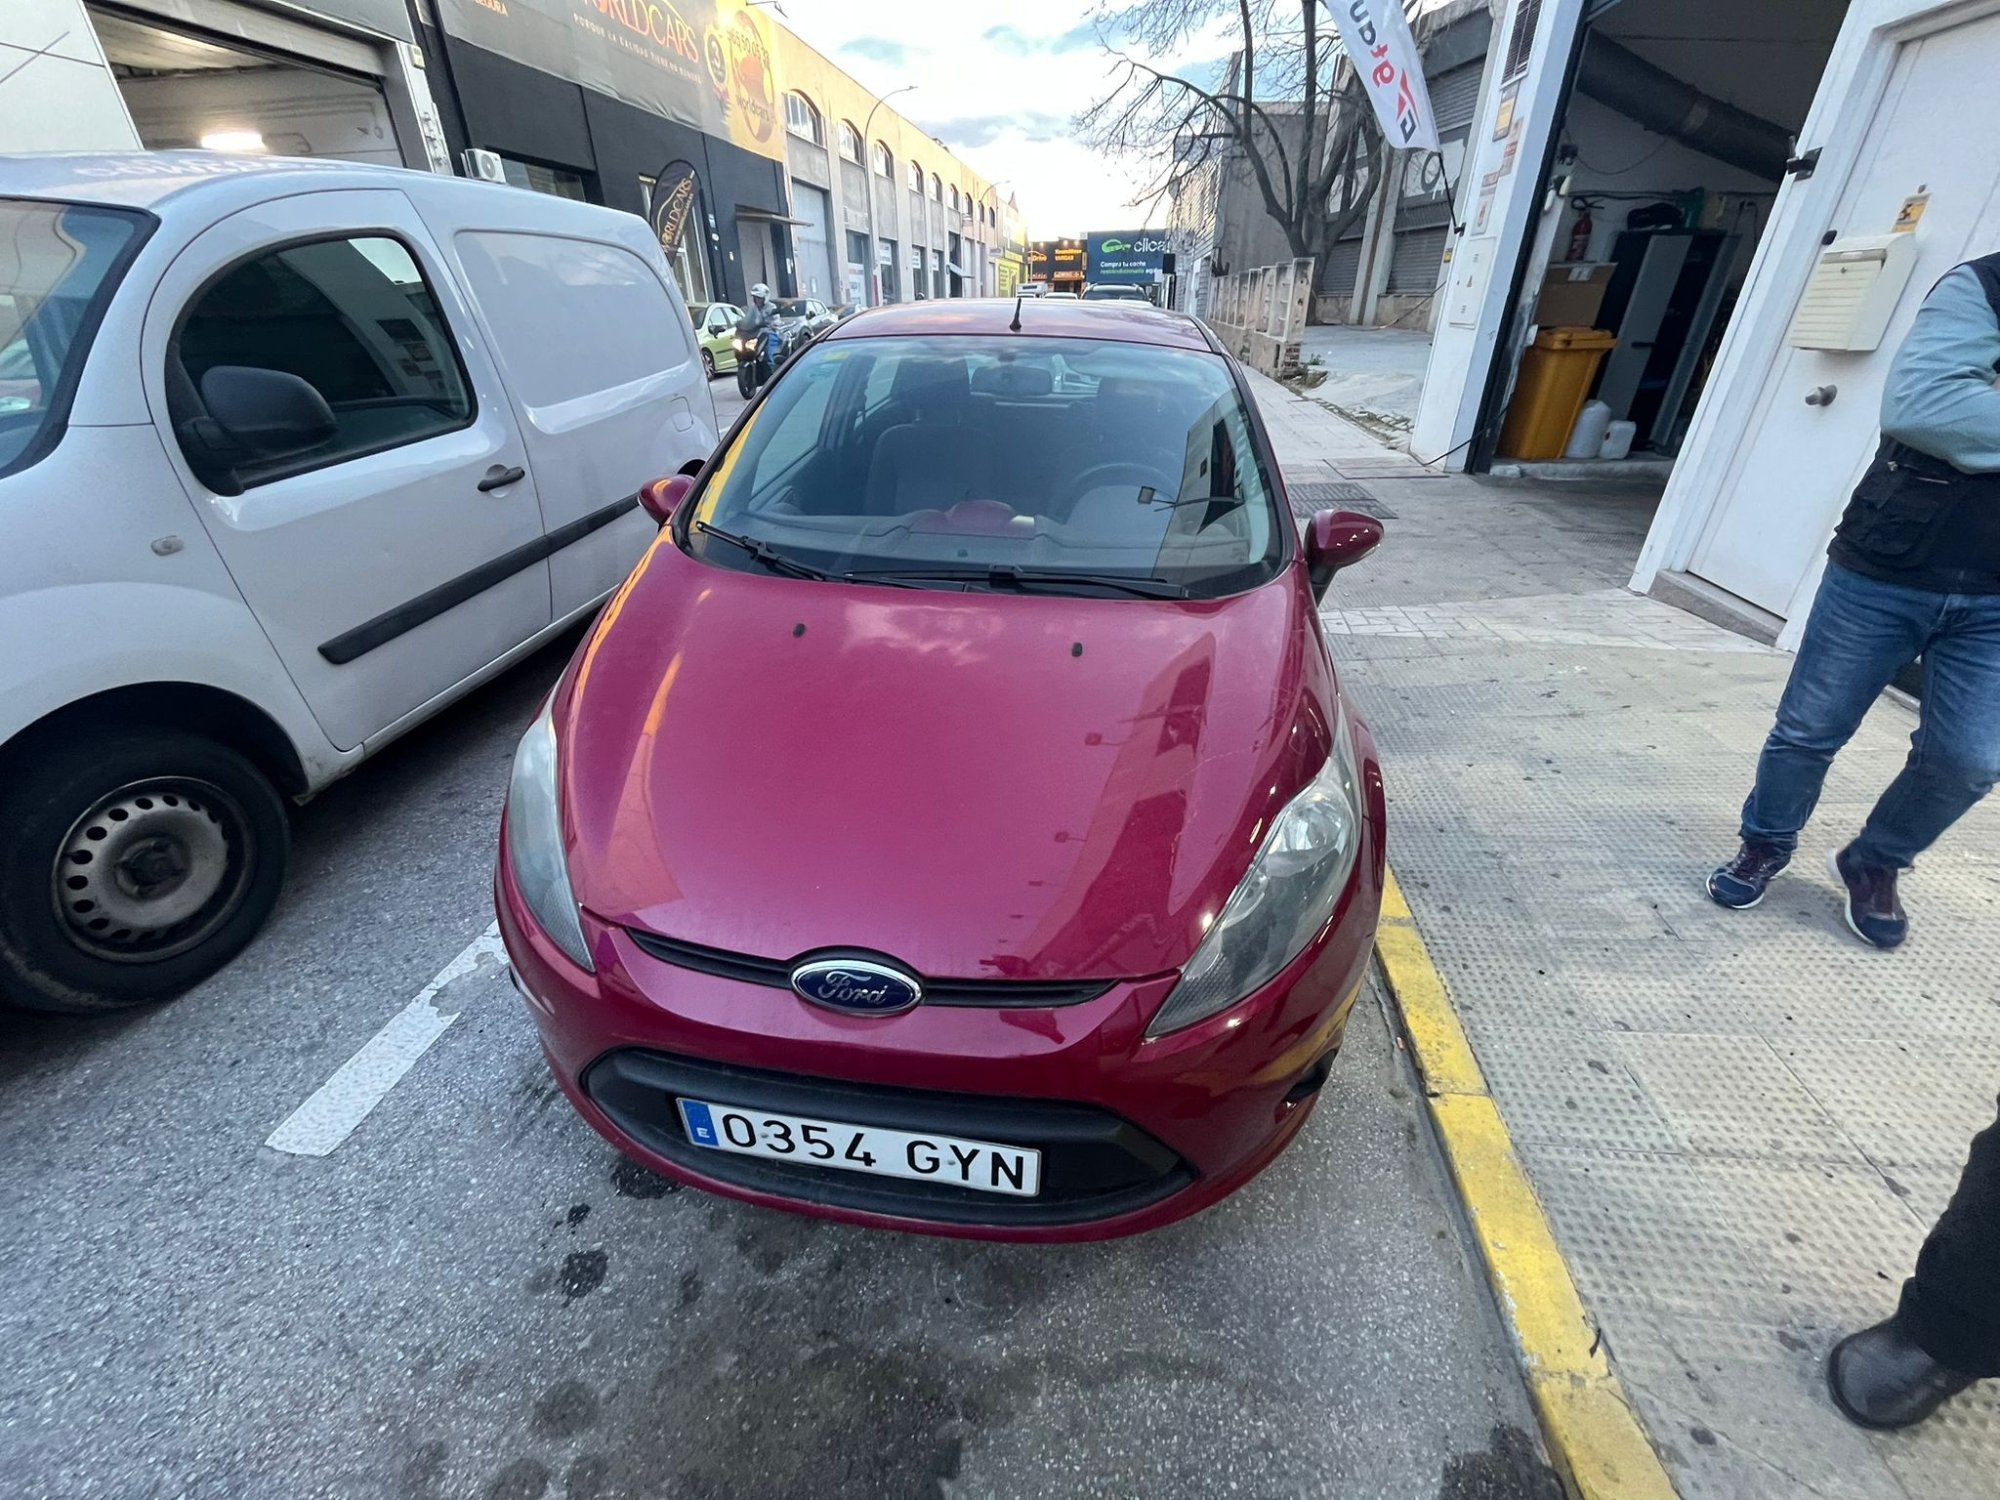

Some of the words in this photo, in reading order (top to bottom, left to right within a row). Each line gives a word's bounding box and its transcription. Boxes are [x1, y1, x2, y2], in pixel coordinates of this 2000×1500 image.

[818, 970, 889, 1005] Ford
[720, 1112, 877, 1168] 0354
[905, 1139, 1025, 1191] GYN
